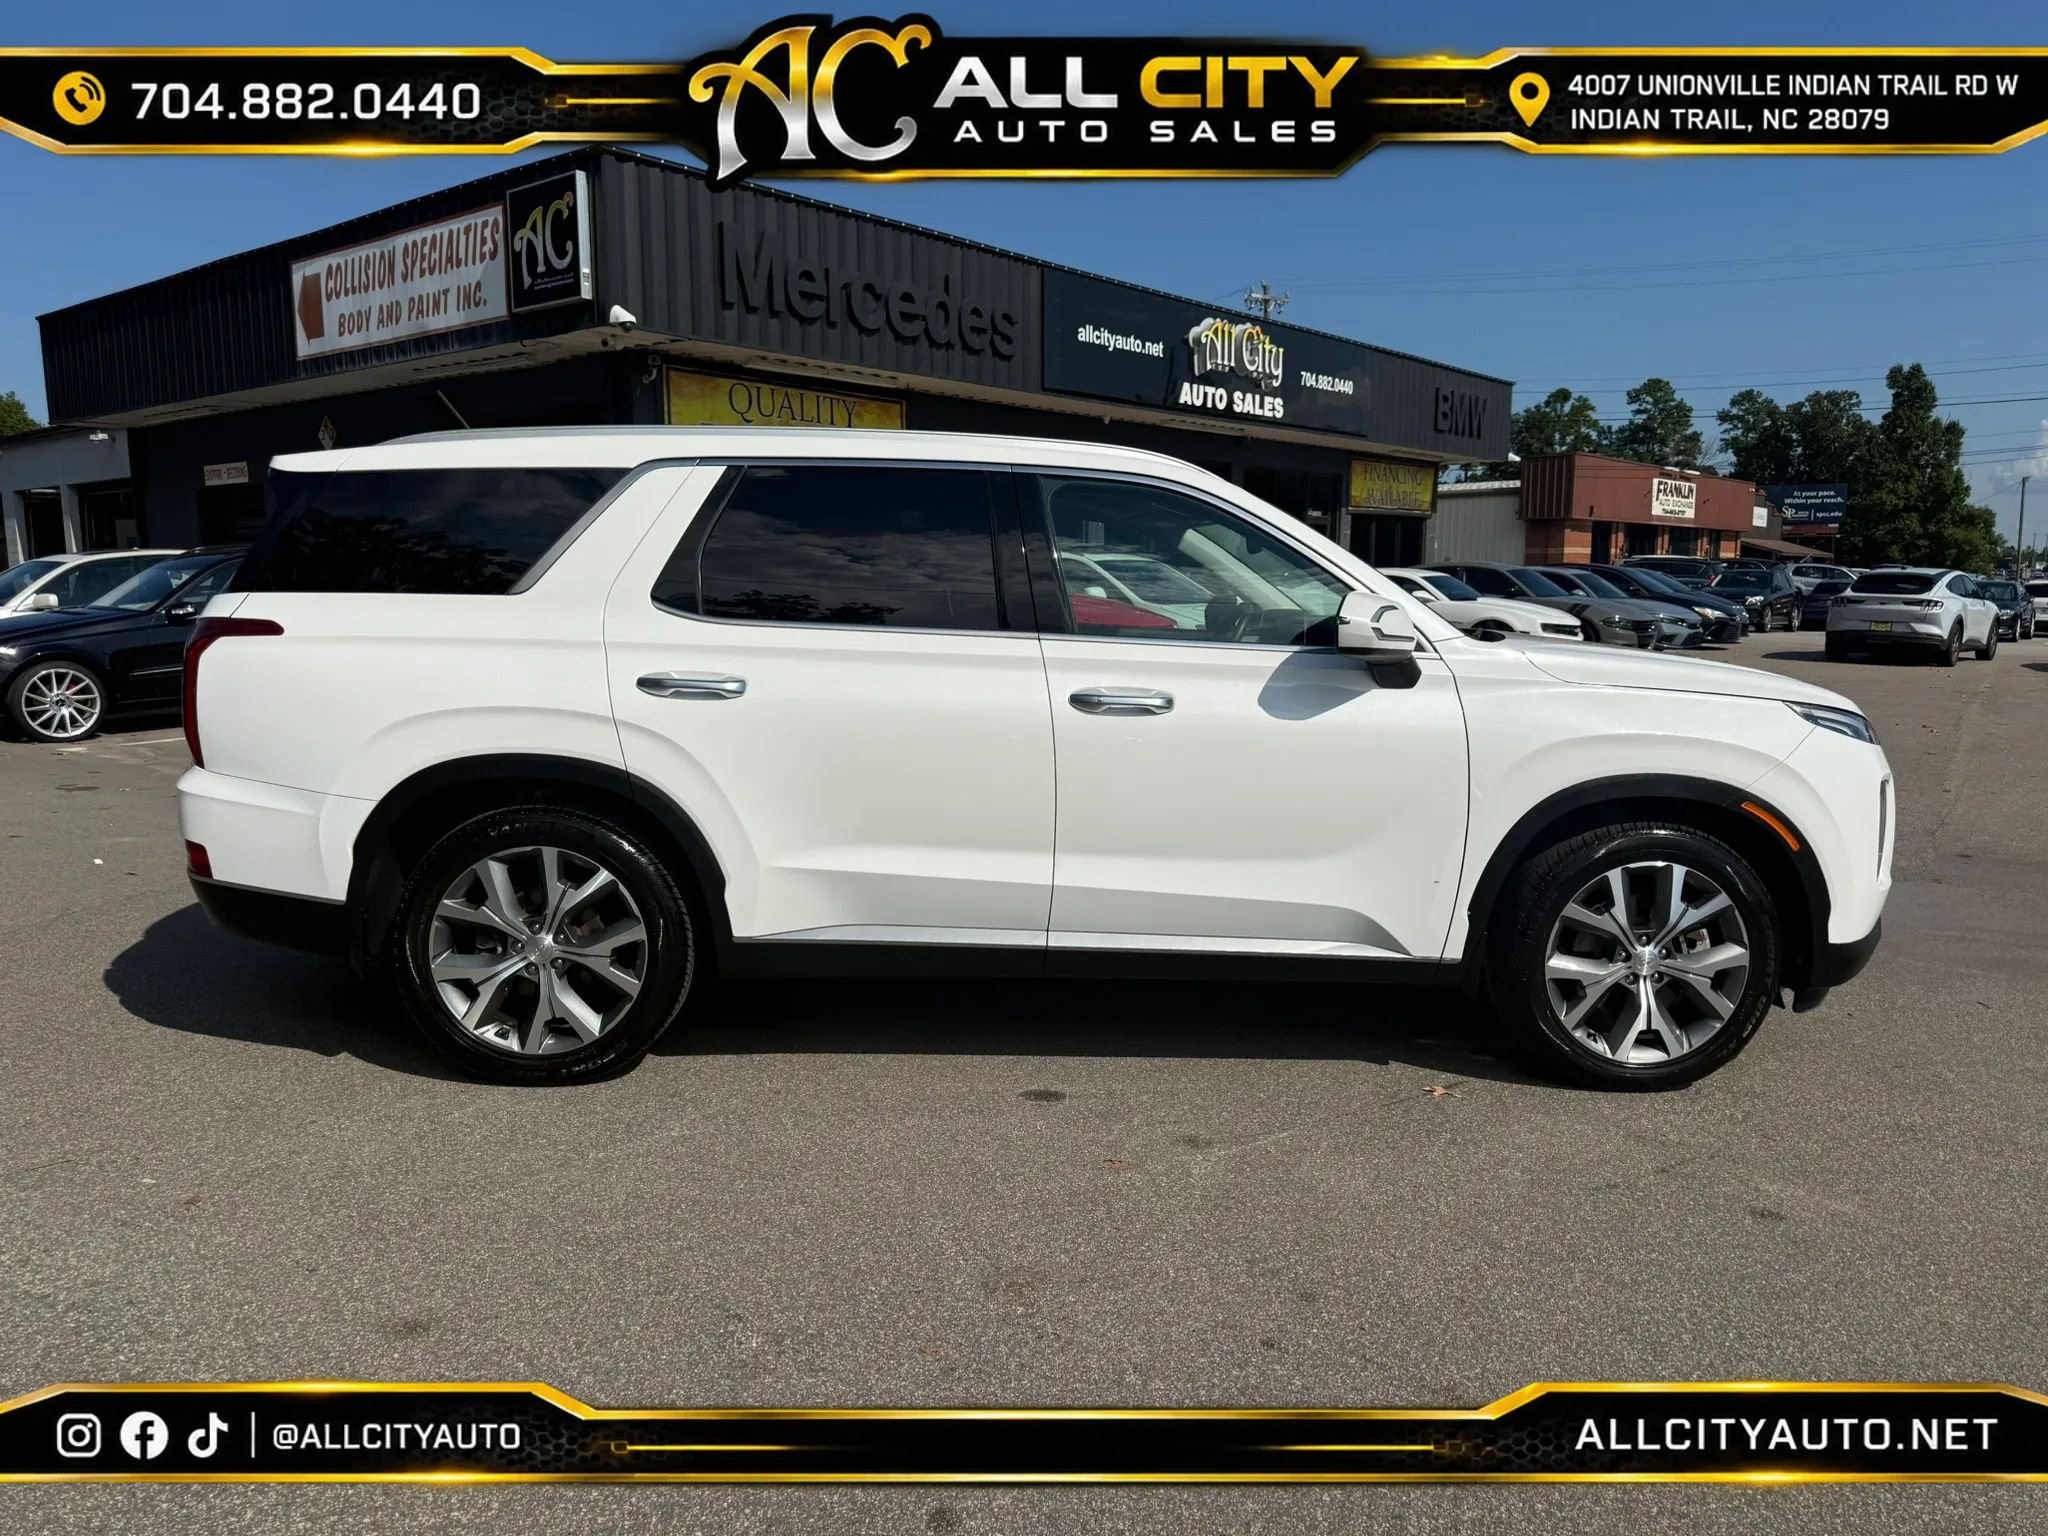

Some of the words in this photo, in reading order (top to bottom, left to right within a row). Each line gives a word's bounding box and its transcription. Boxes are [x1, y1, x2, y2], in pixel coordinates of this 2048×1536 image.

[325, 245, 396, 302] COLLISION
[401, 216, 500, 283] SPECIALTIES
[338, 306, 372, 337] BODY
[377, 300, 402, 330] AND
[408, 287, 450, 321] PAINT
[456, 280, 487, 312] INC.
[717, 219, 1019, 362] Mercedes
[1077, 325, 1164, 358] allcityauto.net
[1201, 319, 1236, 370] All
[1243, 325, 1285, 388] City
[728, 382, 858, 428] QUALITY
[1179, 382, 1228, 410] AUTO
[1232, 390, 1284, 419] SALES
[1300, 371, 1354, 395] 704.882.0440
[1434, 387, 1487, 439] BMW
[1363, 464, 1424, 486] FINANCING
[1656, 480, 1694, 501] FRANKLIN
